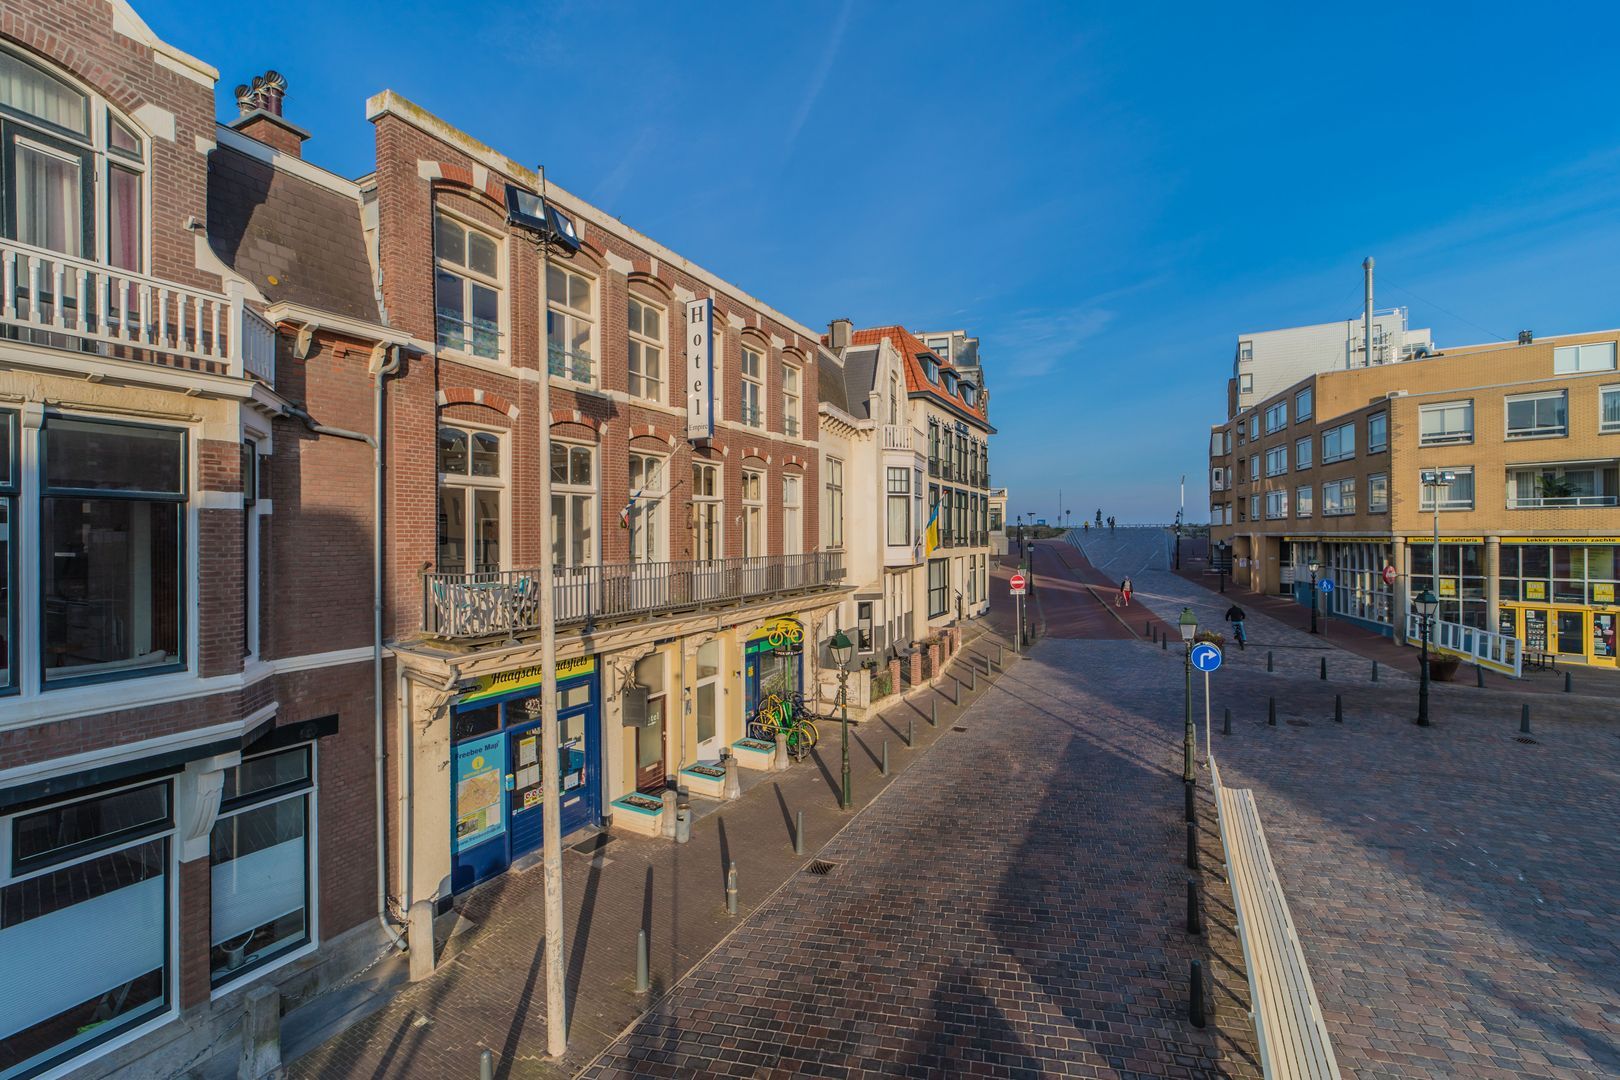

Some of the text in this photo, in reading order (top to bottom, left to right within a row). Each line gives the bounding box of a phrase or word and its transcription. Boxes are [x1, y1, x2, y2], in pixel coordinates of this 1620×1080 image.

[690, 305, 704, 416] Hotel
[688, 423, 708, 432] Empire
[491, 655, 588, 685] Haagsche adsfiets
[455, 742, 499, 760] Freebee Map
